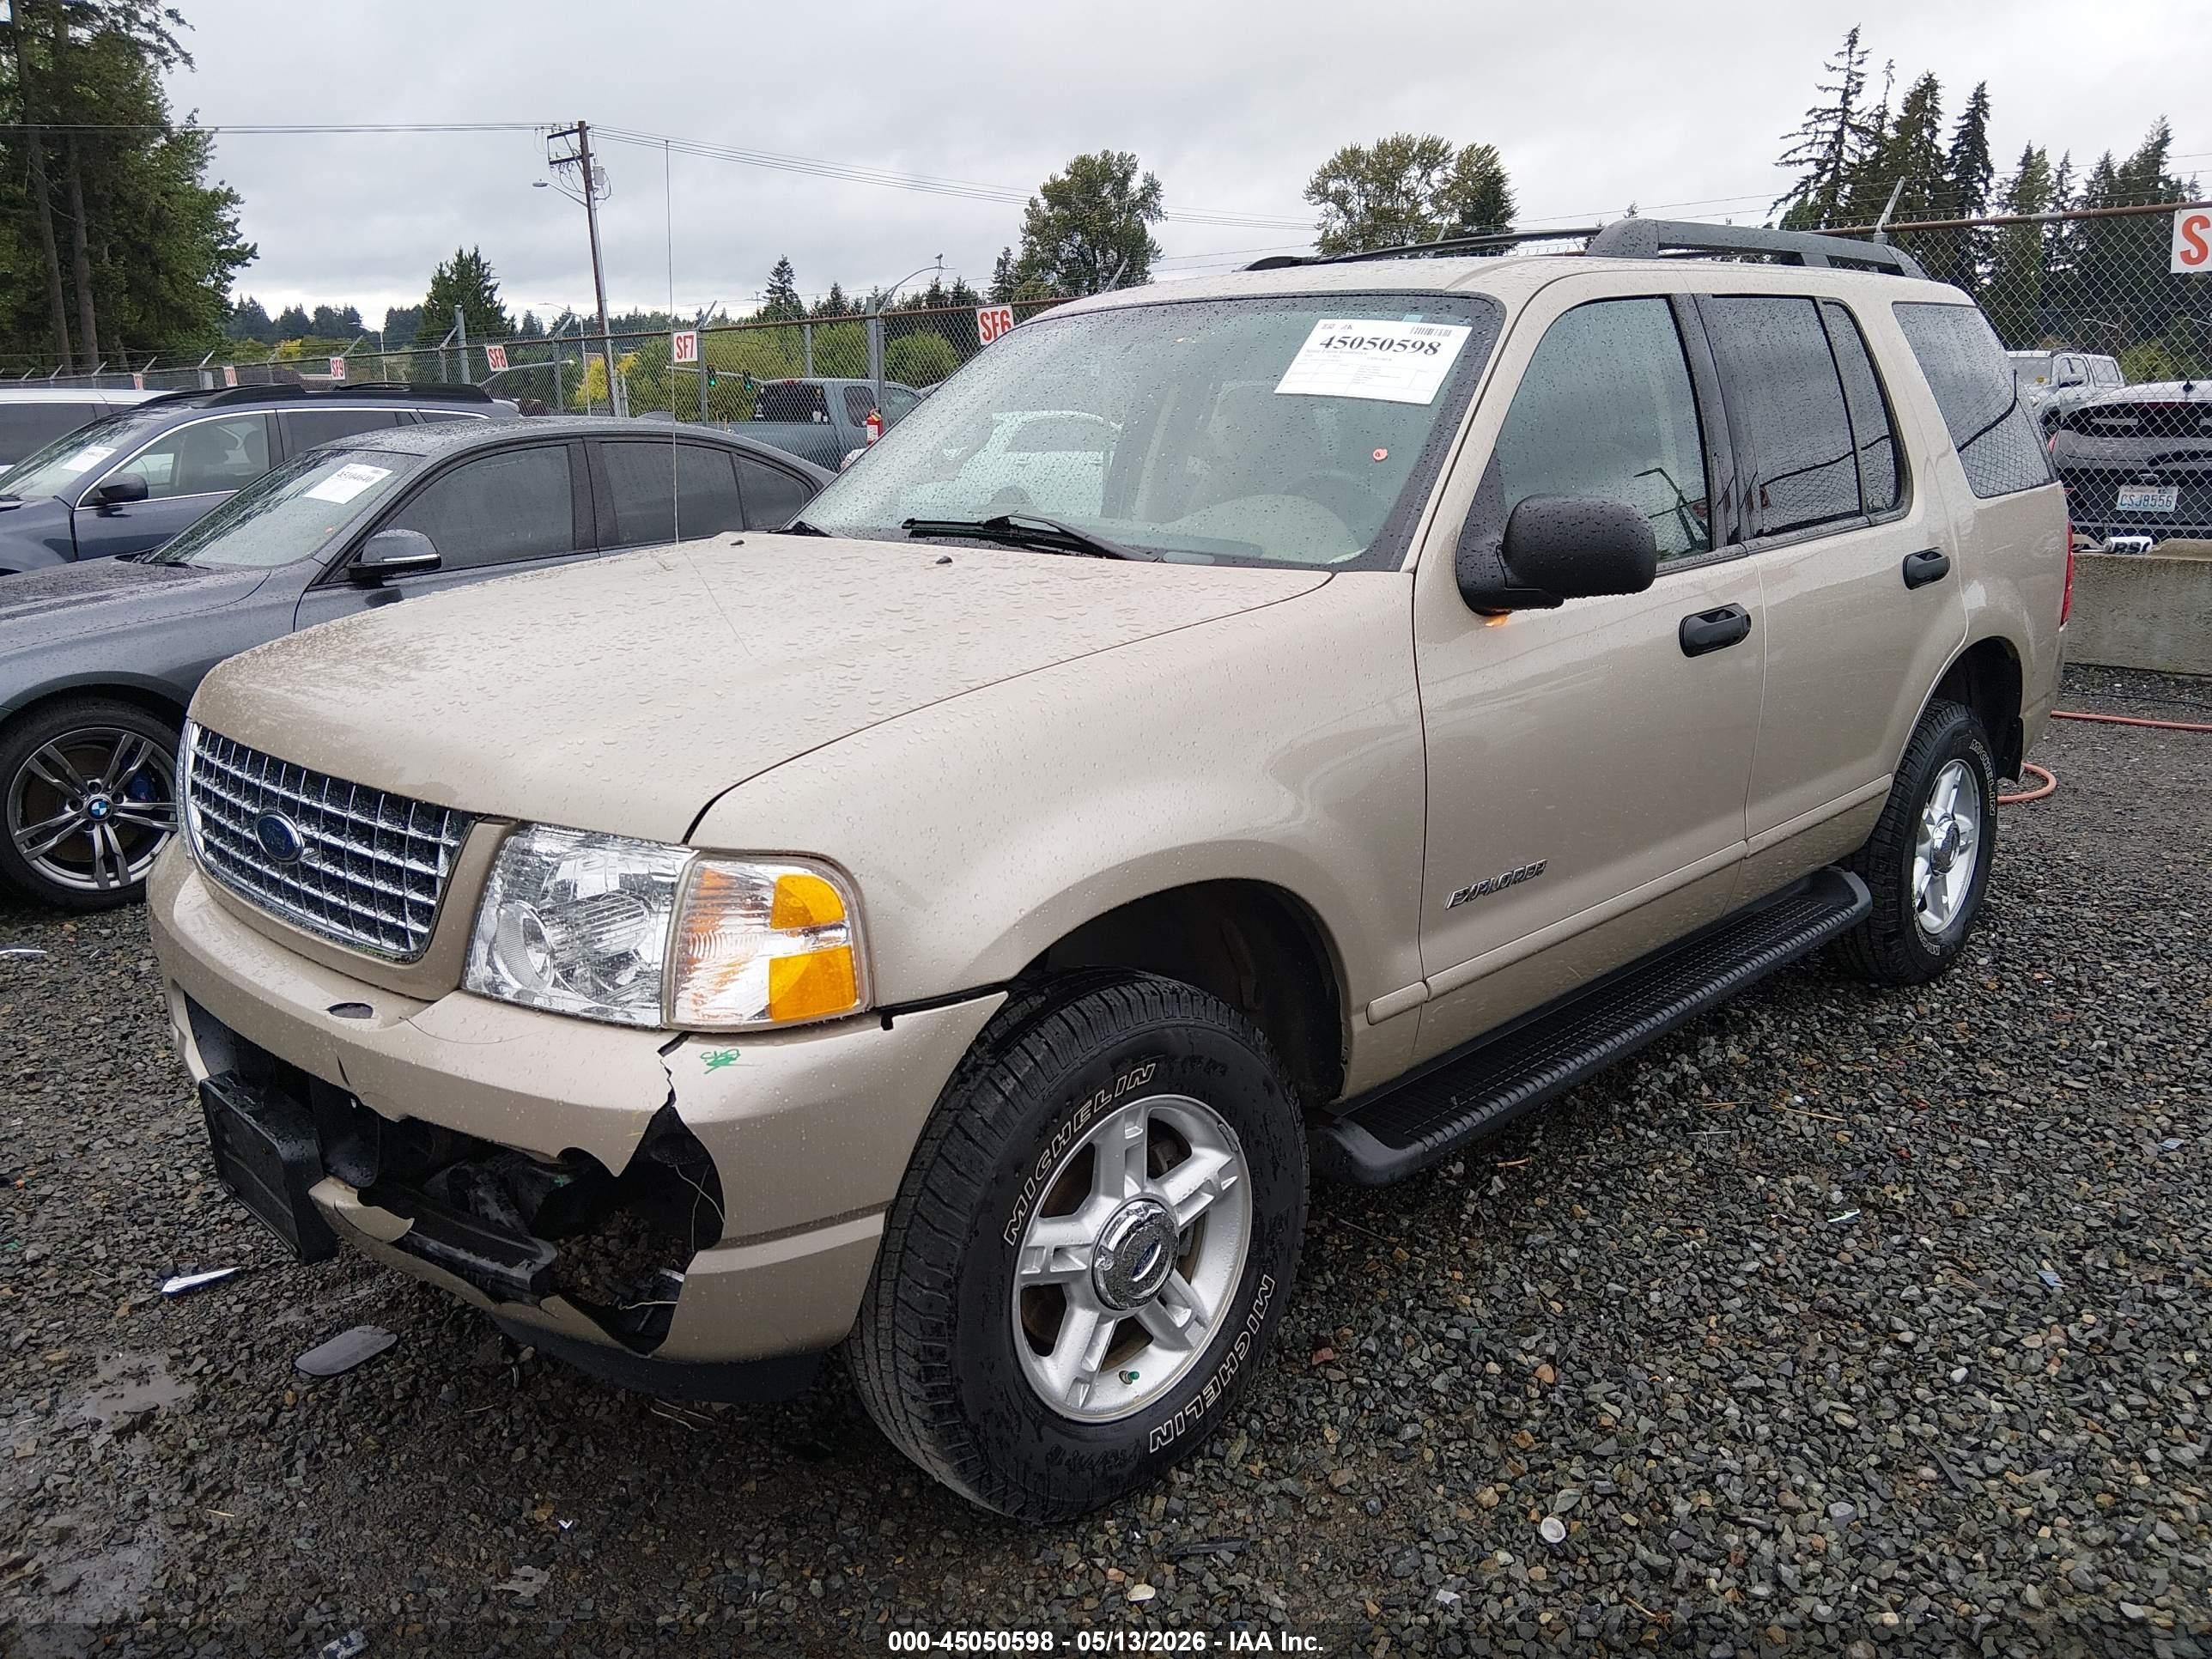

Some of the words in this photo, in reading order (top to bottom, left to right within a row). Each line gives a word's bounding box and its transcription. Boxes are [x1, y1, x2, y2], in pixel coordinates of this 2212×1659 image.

[979, 309, 1012, 342] SF6
[488, 347, 507, 369] SF8
[676, 334, 695, 360] SF7
[1319, 334, 1442, 356] 45050598
[331, 358, 344, 378] SF9
[2120, 494, 2173, 508] CSJ8556
[1968, 738, 1996, 817] MICHELIN
[1444, 859, 1548, 910] EXPLORER
[1003, 1062, 1157, 1247] MICHELIN
[1149, 1273, 1276, 1454] MICHELIN
